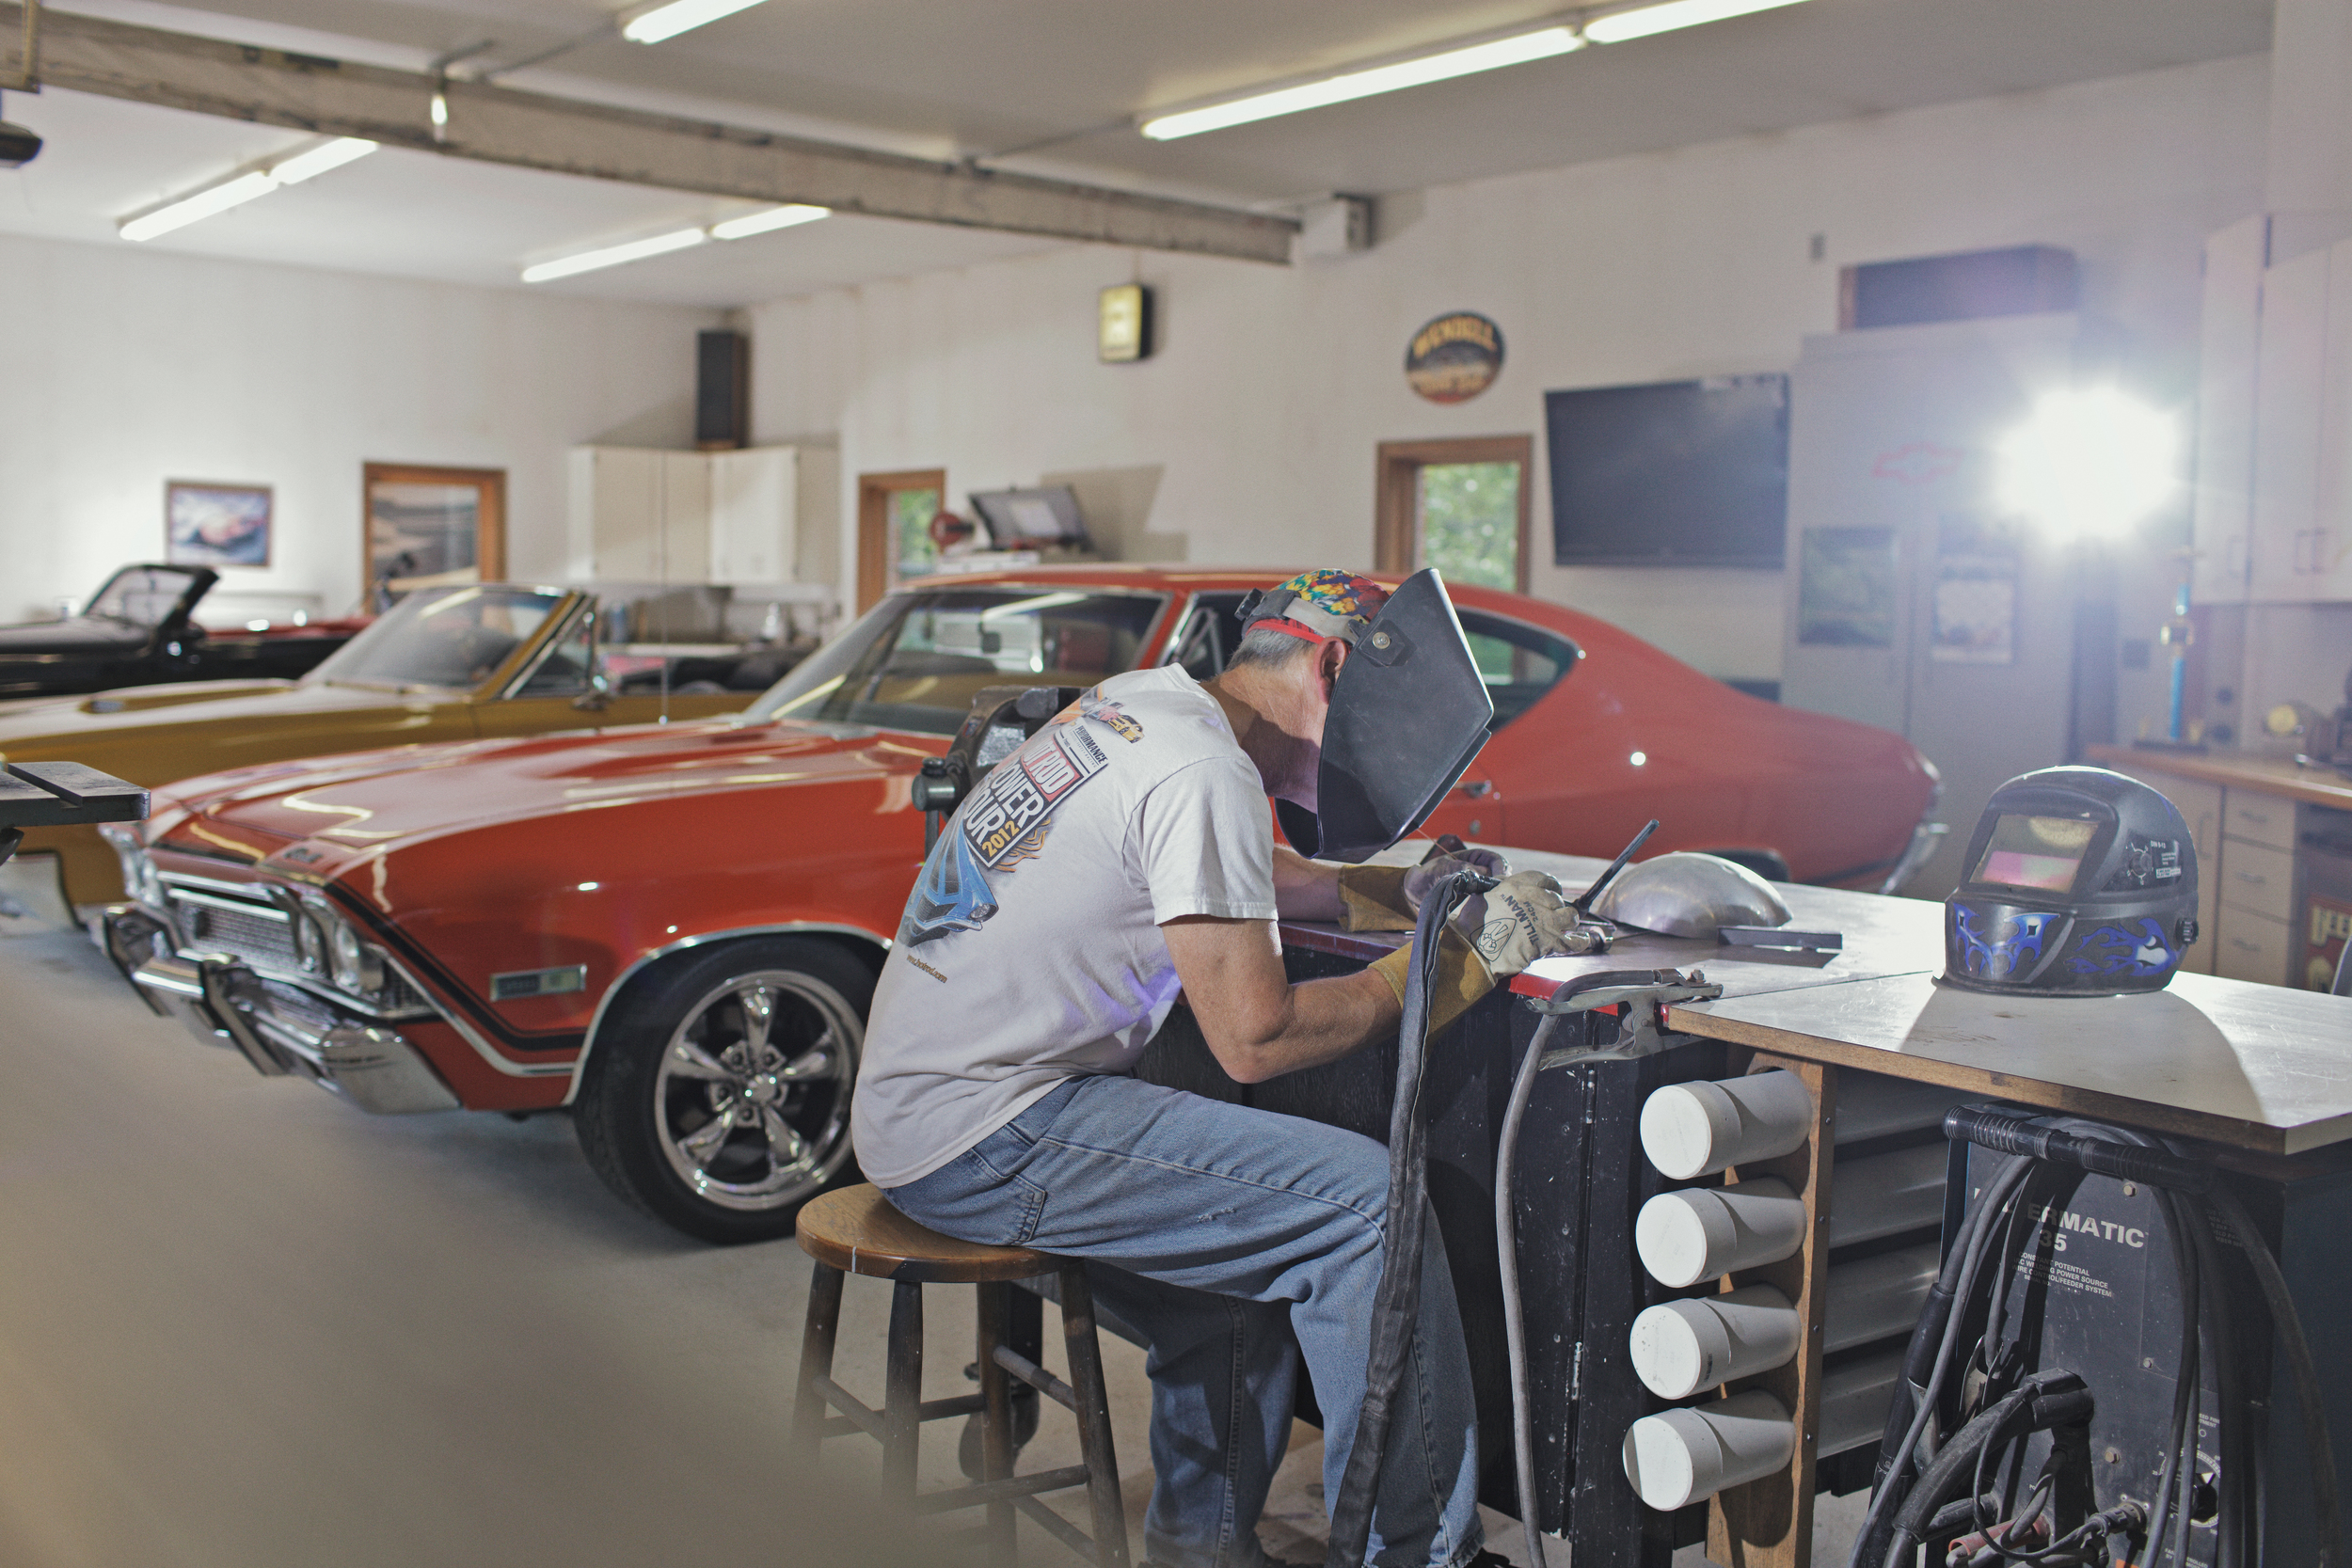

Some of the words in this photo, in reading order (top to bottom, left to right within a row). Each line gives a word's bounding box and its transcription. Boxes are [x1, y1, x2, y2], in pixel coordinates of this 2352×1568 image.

[1074, 725, 1108, 764] PERFORMANCE
[1029, 753, 1075, 795] ROD
[982, 820, 1020, 857] 2012
[2055, 1261, 2090, 1276] POTENTIAL
[2057, 1269, 2080, 1281] POWER
[2081, 1275, 2108, 1289] SOURCE
[2085, 1285, 2112, 1297] SYSTEM
